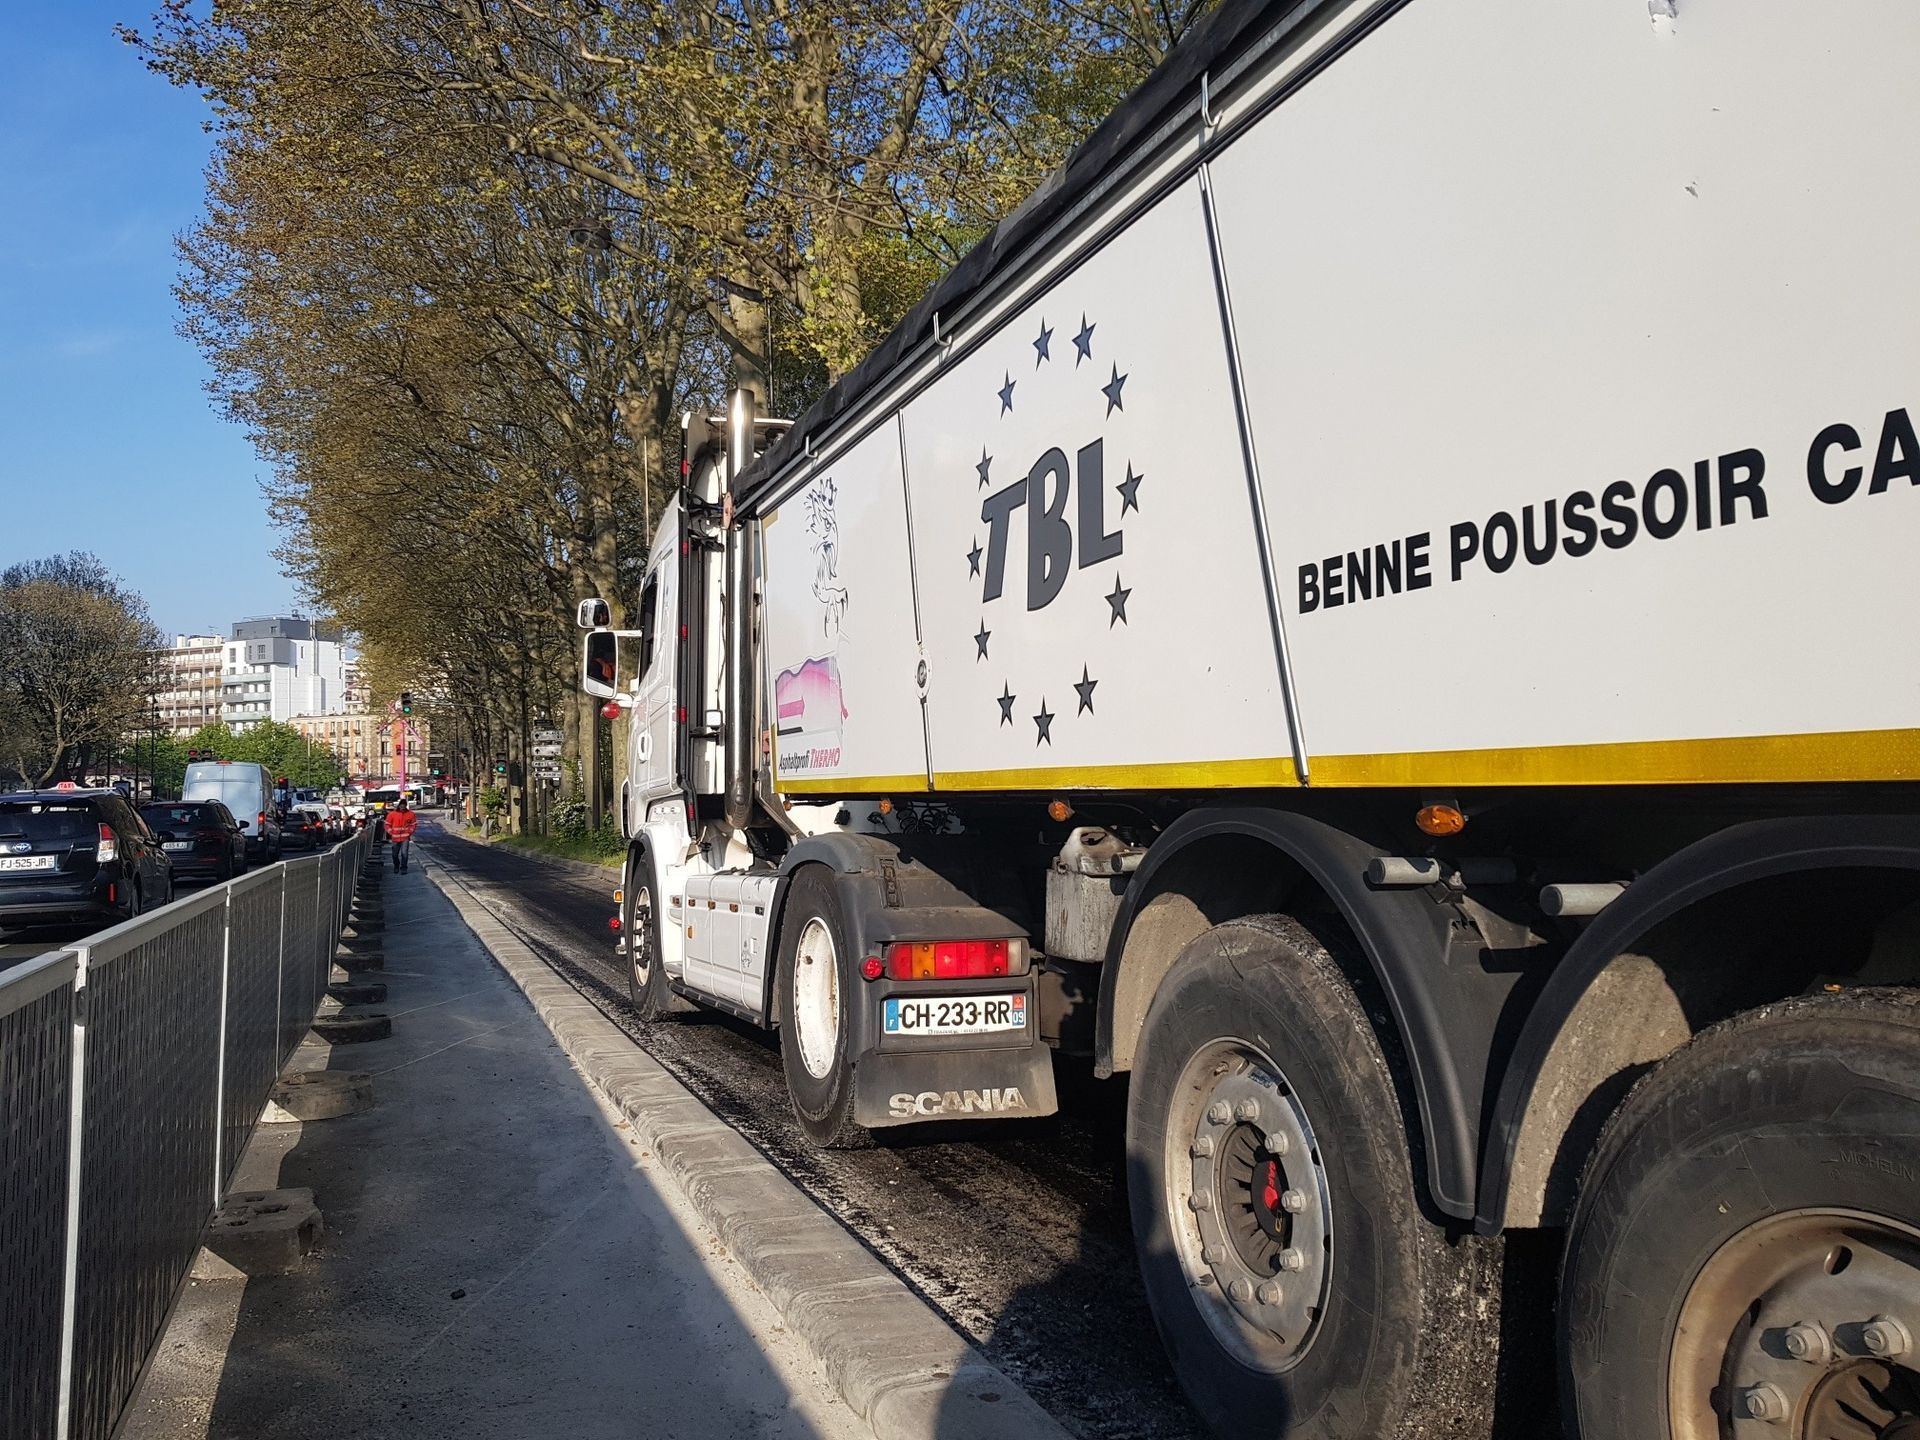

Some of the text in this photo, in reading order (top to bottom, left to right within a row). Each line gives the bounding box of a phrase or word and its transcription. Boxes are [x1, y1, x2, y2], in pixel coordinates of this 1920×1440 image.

[981, 437, 1123, 611] TBL
[1298, 531, 1432, 614] BENNE
[1450, 447, 1769, 582] POUSSOIR
[901, 1000, 1011, 1029] CH-233-RR
[888, 1087, 1028, 1118] SCANIA
[1839, 1148, 1915, 1183] MICHELIN
